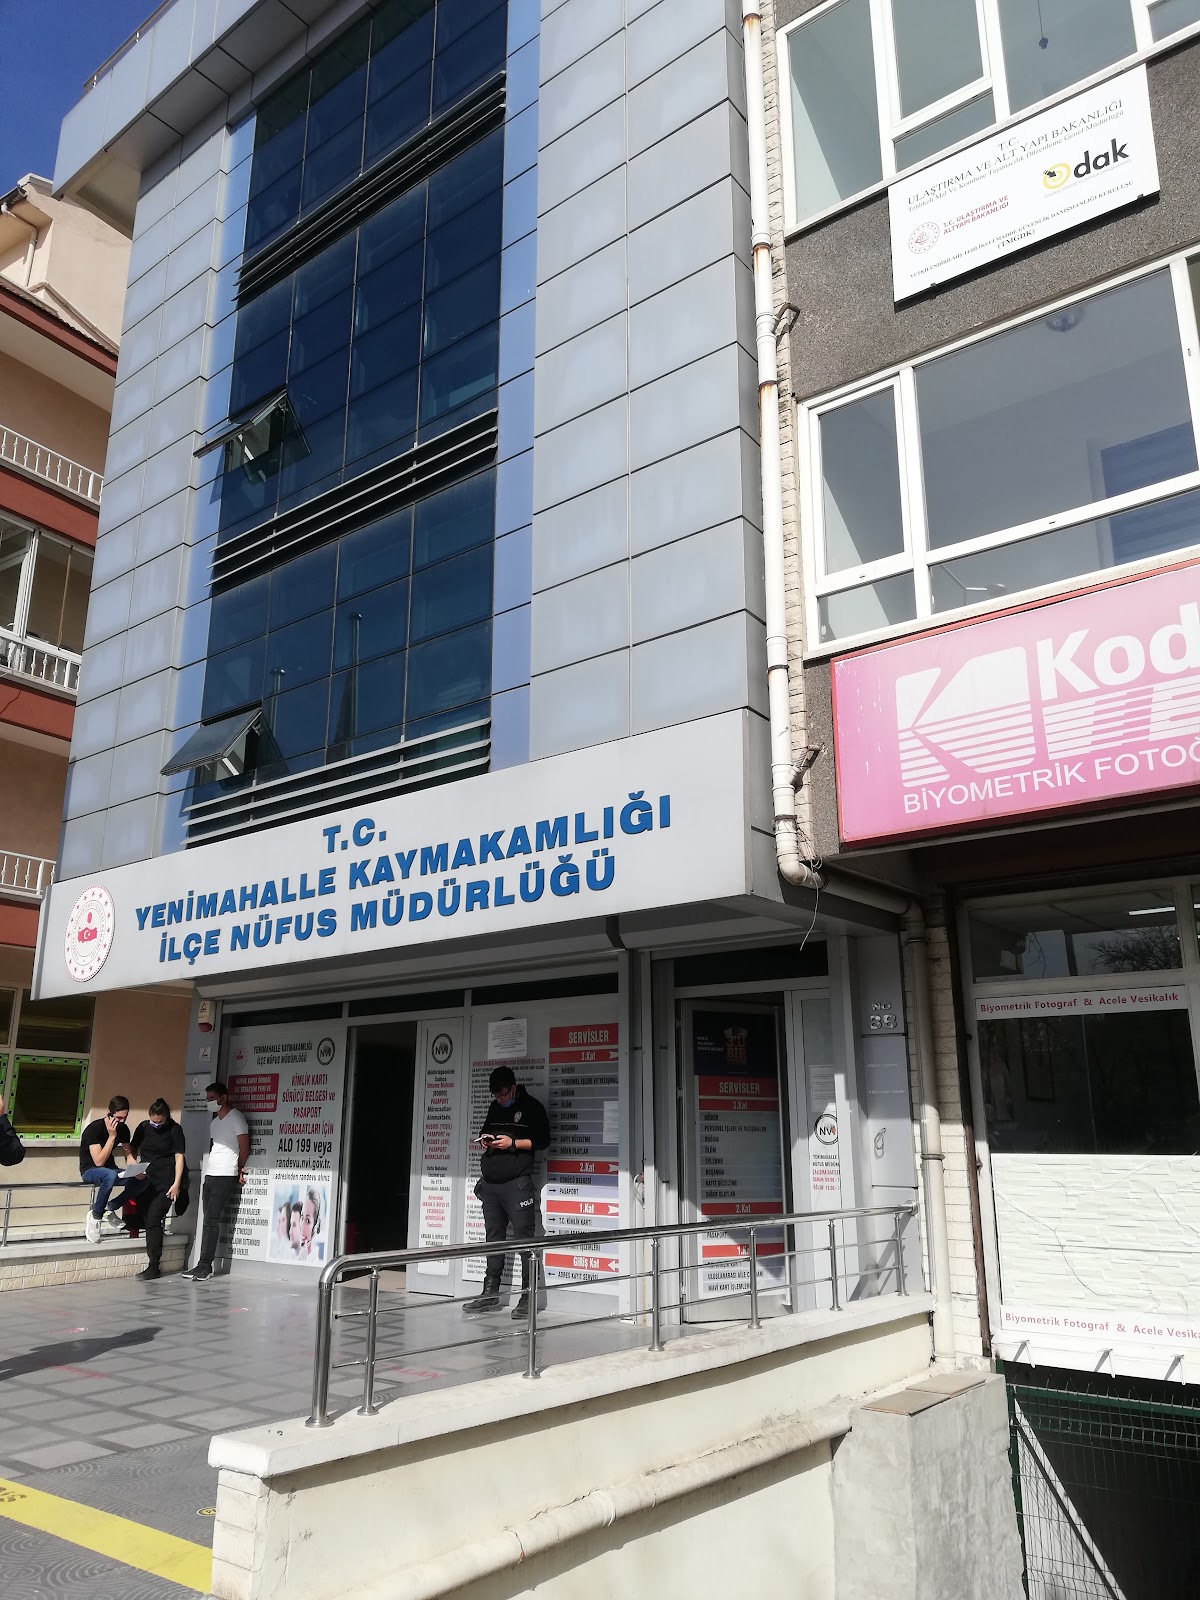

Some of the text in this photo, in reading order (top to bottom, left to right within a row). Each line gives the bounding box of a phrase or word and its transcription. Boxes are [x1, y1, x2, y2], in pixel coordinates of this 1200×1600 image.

[1026, 139, 1063, 158] Düzenleme
[1063, 127, 1084, 141] Genel
[908, 170, 972, 204] ULAŞTIRMA
[976, 161, 991, 173] VE
[1020, 134, 1048, 152] YAPI
[1051, 99, 1122, 139] BAKANLIĞI
[956, 200, 998, 222] ULAŞTIRMA
[999, 194, 1009, 203] VE
[943, 219, 971, 235] ALTYAPI
[904, 760, 1086, 814] BİYOMETRİK
[322, 818, 387, 853] T.C.
[135, 866, 337, 931] YENİMAHALLE
[349, 790, 671, 890] KAYMAKAMLIĞI
[159, 847, 615, 965] İLÇE NÜFUS MÜDÜRLÜĞÜ
[980, 1001, 1032, 1013] Biyometrik
[1083, 997, 1093, 1006] &
[1099, 995, 1127, 1005] Acele
[1130, 992, 1179, 1003] Vesikalık
[568, 1028, 609, 1044] SERVİSLER
[581, 1051, 596, 1061] 3.Kat
[291, 1072, 328, 1087] KİMLİK KARTI
[719, 1080, 761, 1094] SERVİSLER
[281, 1087, 336, 1103] SÜRÜCÜ BELGESİ ve
[293, 1106, 321, 1118] PASAPORT
[732, 1101, 748, 1110] 3.Kat
[279, 1120, 321, 1135] MÜRACAATLARI
[321, 1120, 334, 1137] İÇİN
[278, 1138, 293, 1152] ALO
[295, 1138, 311, 1152] 199
[313, 1141, 332, 1159] veya
[579, 1162, 595, 1173] 2.Kat
[559, 1187, 579, 1196] PASAPORT
[579, 1203, 595, 1214] 1.Kat
[735, 1204, 751, 1214] 2.Kat
[706, 1231, 728, 1239] PASAPORT
[589, 1257, 600, 1269] Kat
[557, 1271, 571, 1279] ADRES
[719, 1283, 730, 1291] KART
[1005, 1312, 1060, 1327] Biyometrik
[1116, 1323, 1126, 1332] &
[1133, 1325, 1163, 1336] Acele
